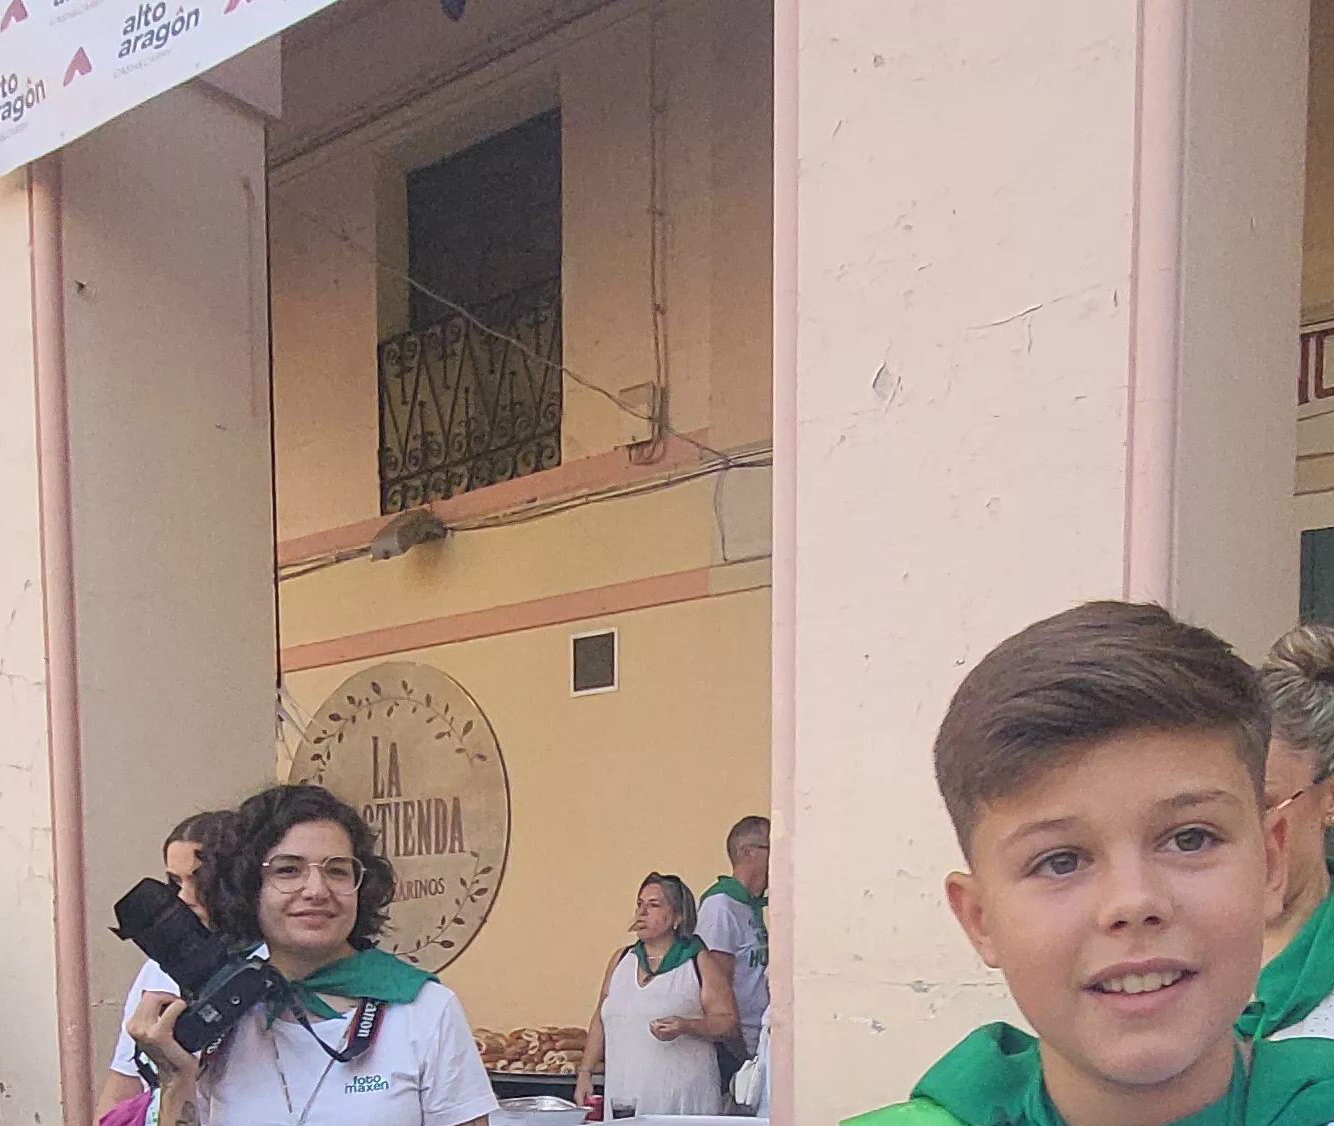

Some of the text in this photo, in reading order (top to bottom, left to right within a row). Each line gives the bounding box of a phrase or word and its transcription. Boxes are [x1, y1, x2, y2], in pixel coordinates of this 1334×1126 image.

[117, 5, 200, 59] aragón
[122, 1, 167, 36] alto
[372, 736, 402, 799] LA
[391, 877, 445, 902] ARINOS
[357, 1001, 380, 1038] anon
[353, 1074, 382, 1086] foto
